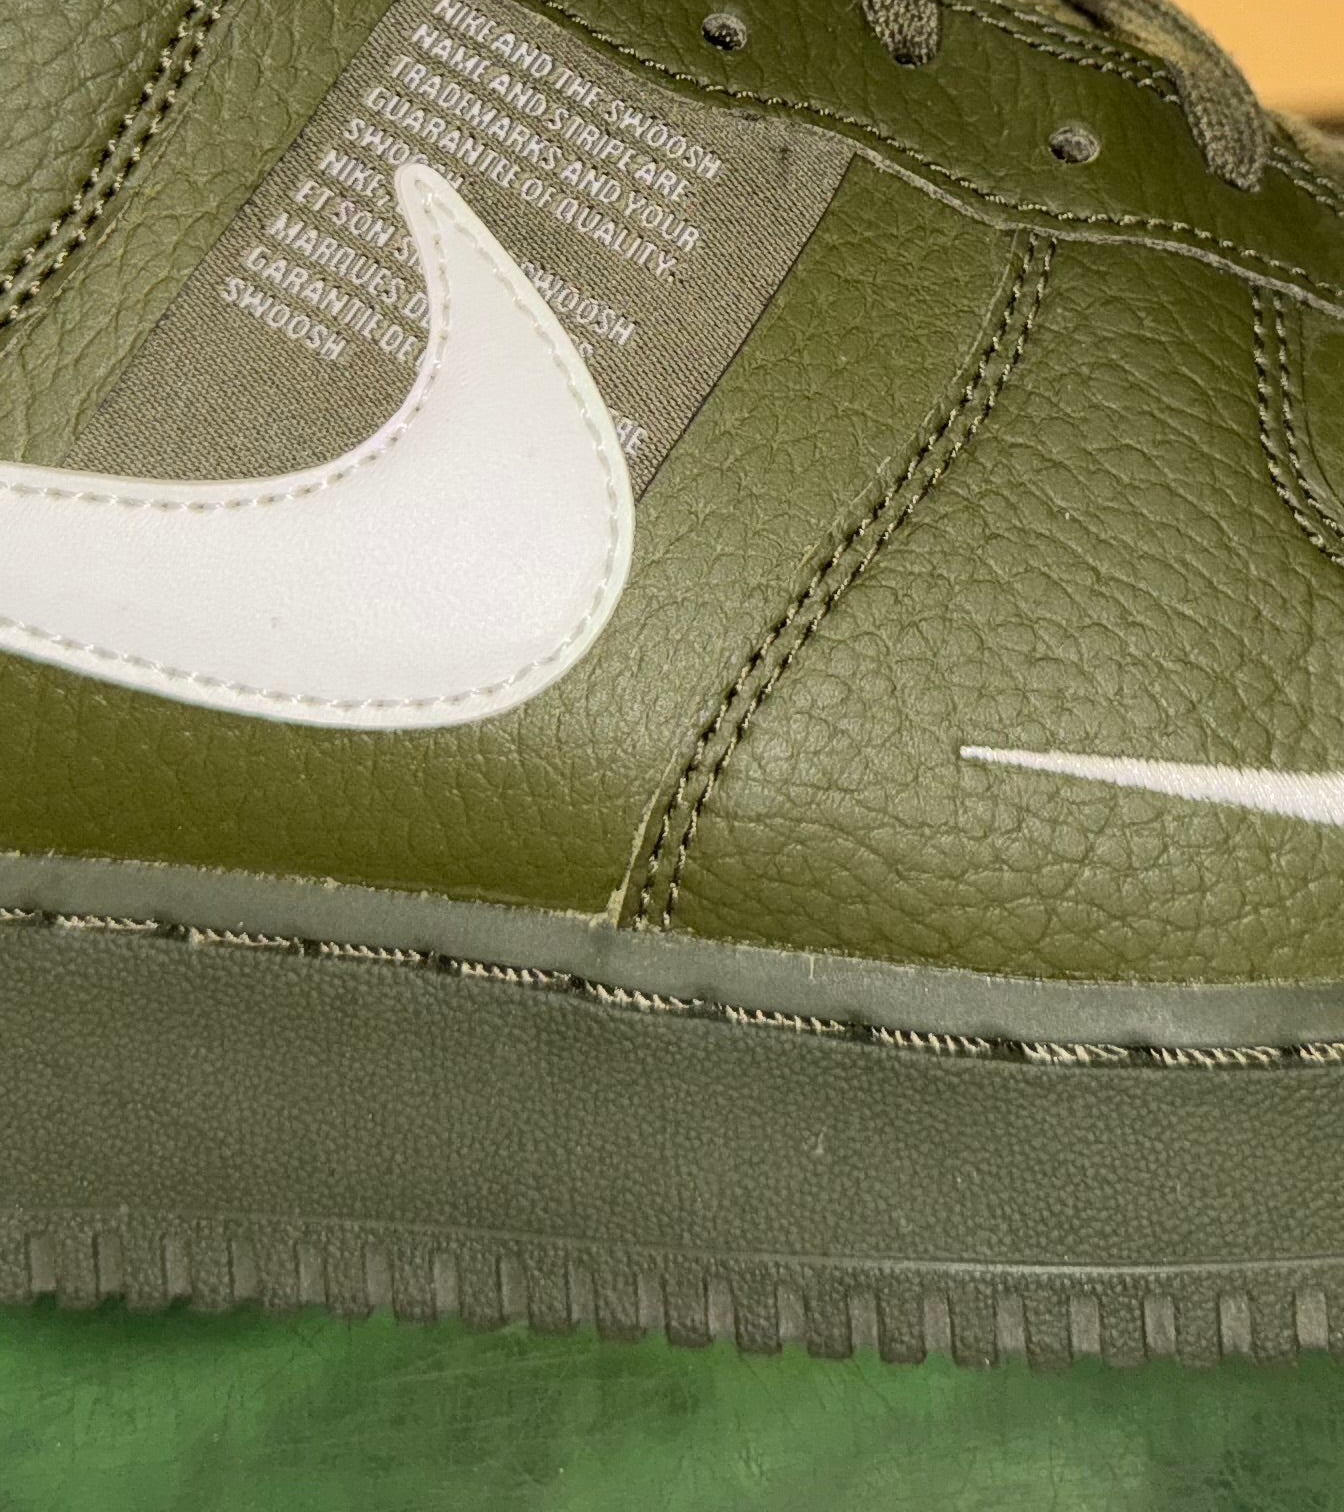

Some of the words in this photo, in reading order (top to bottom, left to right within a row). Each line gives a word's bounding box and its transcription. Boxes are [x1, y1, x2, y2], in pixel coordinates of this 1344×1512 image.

[366, 86, 520, 189] GUARANTEE
[520, 178, 557, 209] OF
[390, 54, 562, 170] TRADEMARKS
[560, 160, 622, 203] AND
[623, 190, 701, 253] YOUR
[411, 23, 491, 83] NAME
[488, 73, 547, 116] AND
[542, 107, 636, 172] STRIPE
[634, 161, 692, 204] ARE
[491, 32, 553, 78] AND
[555, 67, 603, 110] THE
[605, 99, 722, 180] SWOOSH
[268, 212, 406, 304] MARQUES
[294, 180, 335, 213] ET
[331, 200, 396, 248] SON
[222, 276, 347, 361] SWOOSH
[247, 247, 384, 339] GARANTIE
